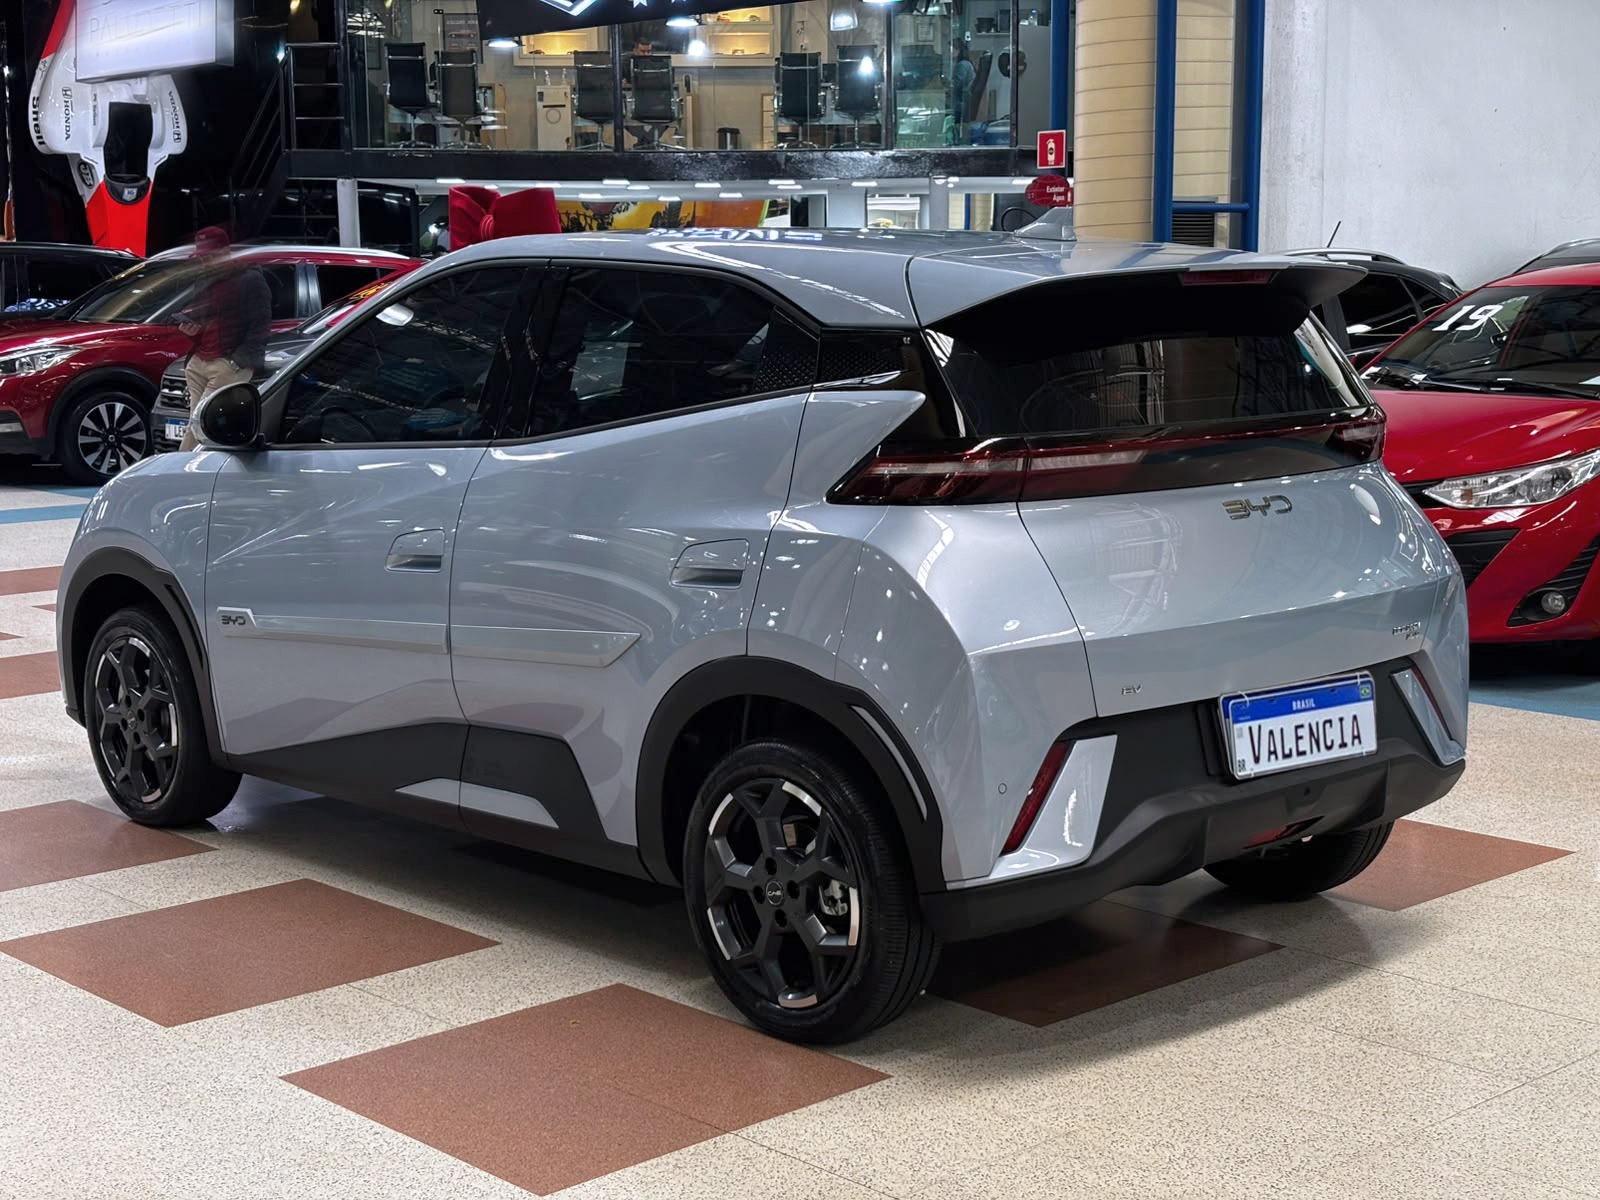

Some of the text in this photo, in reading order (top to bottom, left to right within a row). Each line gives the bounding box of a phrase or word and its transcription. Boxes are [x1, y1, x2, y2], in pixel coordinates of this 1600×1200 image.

[63, 100, 71, 141] HONDA
[168, 90, 180, 129] HONDA
[1431, 304, 1504, 331] 19
[1222, 495, 1292, 520] BYD
[221, 615, 246, 625] BYD
[1121, 684, 1142, 695] EV
[1292, 698, 1316, 711] BRASIL
[1248, 714, 1362, 764] VALENCIA
[1237, 758, 1246, 772] BR
